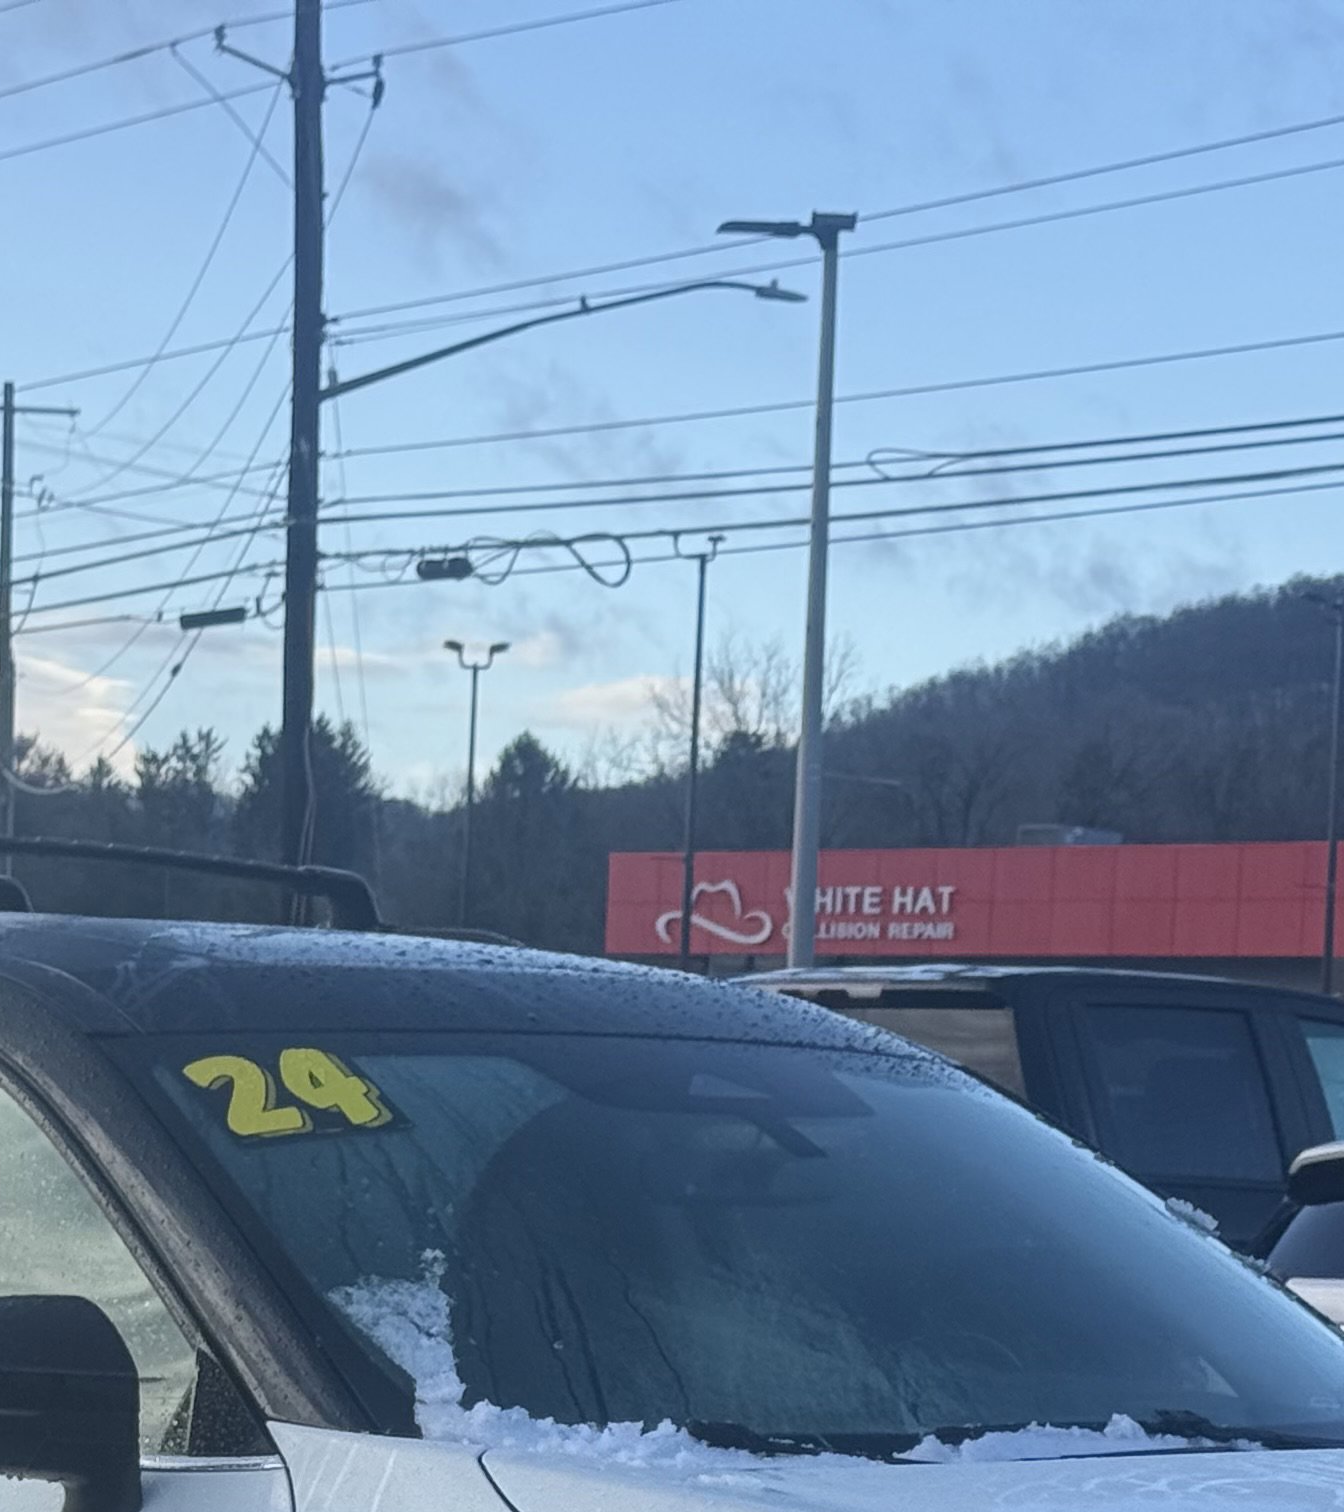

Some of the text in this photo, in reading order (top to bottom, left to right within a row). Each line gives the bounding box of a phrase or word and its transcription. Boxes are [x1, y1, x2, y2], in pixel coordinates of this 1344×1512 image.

[784, 885, 955, 915] HITE HAT
[887, 922, 954, 939] REPAIR
[182, 1048, 393, 1137] 24
